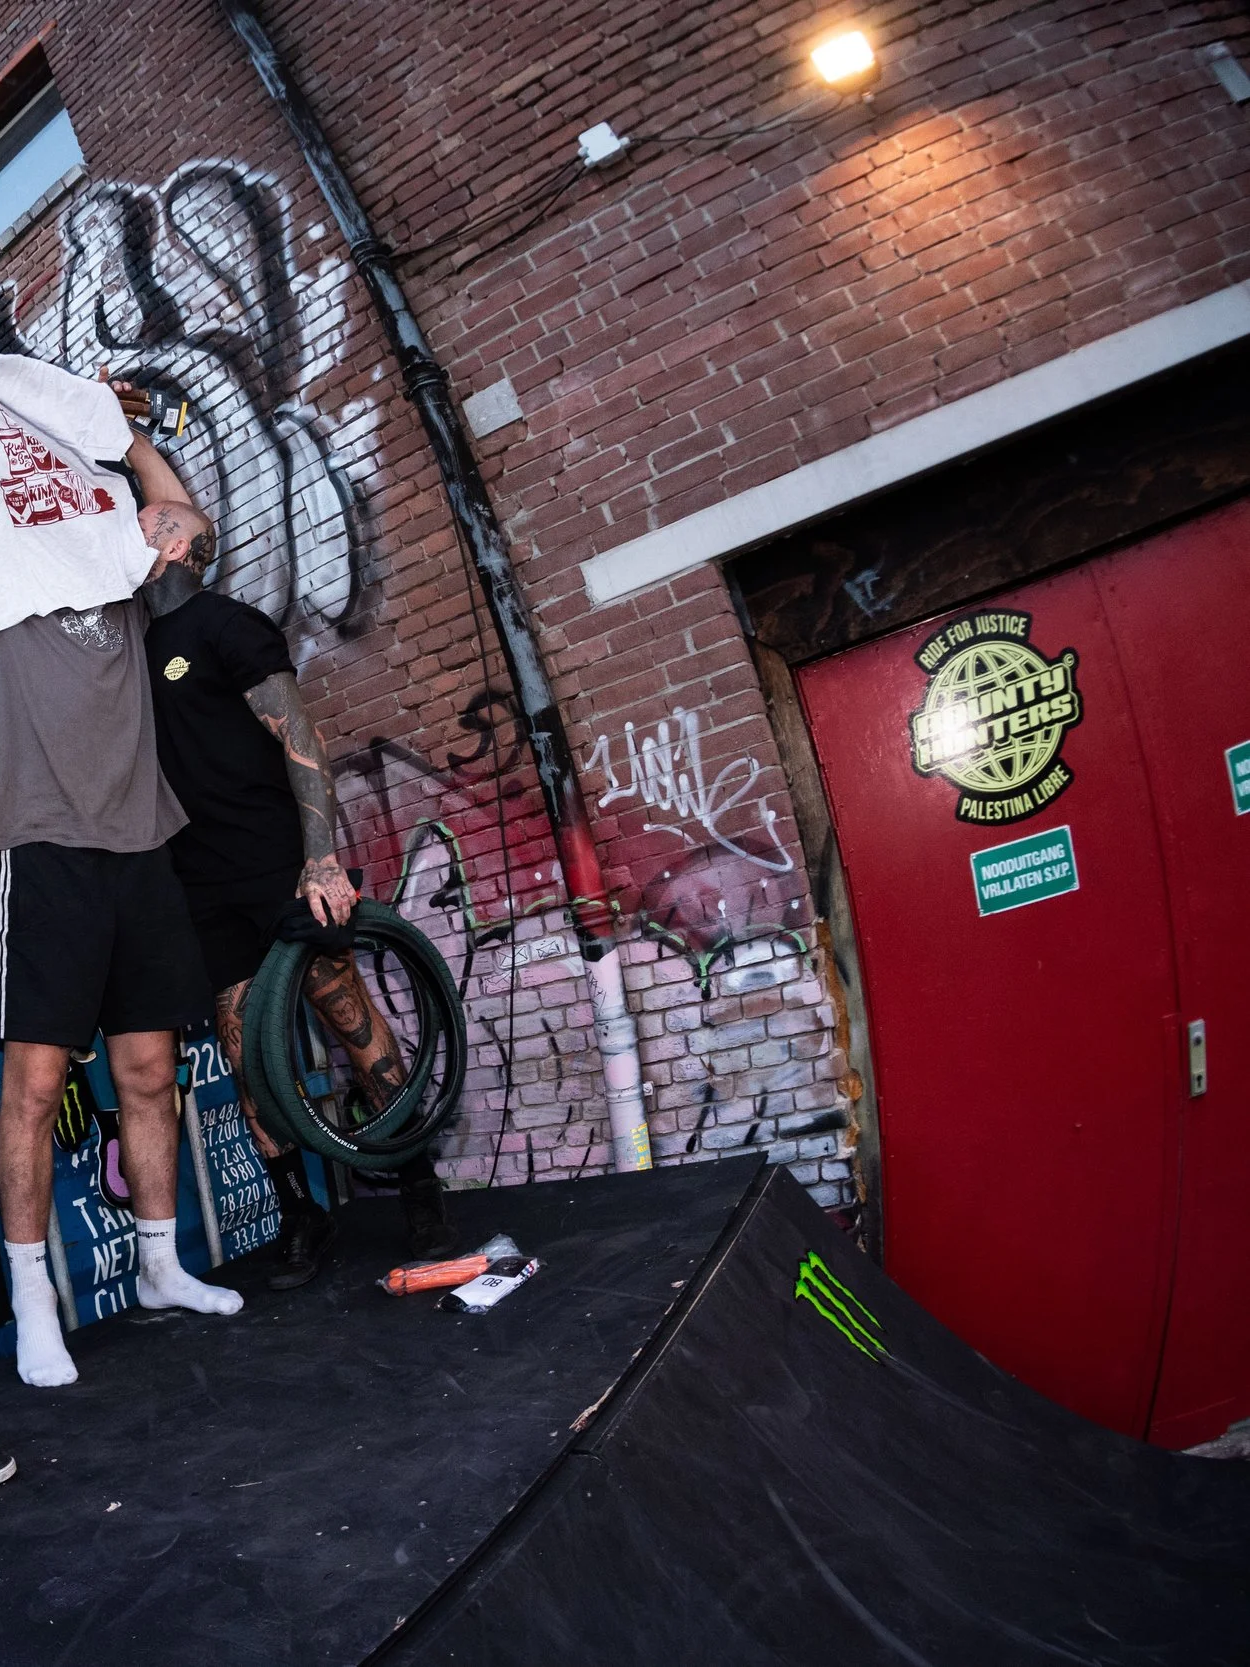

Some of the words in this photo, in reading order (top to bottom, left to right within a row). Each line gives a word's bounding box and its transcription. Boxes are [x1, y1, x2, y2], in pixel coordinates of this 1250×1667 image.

[919, 635, 950, 669] RIDE
[946, 621, 974, 646] FOR
[976, 614, 1028, 636] JUSTICE
[960, 797, 1035, 820] PALESTINA
[1033, 765, 1070, 803] LIBRE
[981, 843, 1066, 880] NOODUITGANG
[980, 870, 1043, 900] VRIJLATEN
[322, 1126, 358, 1151] WETHEPEOPLE
